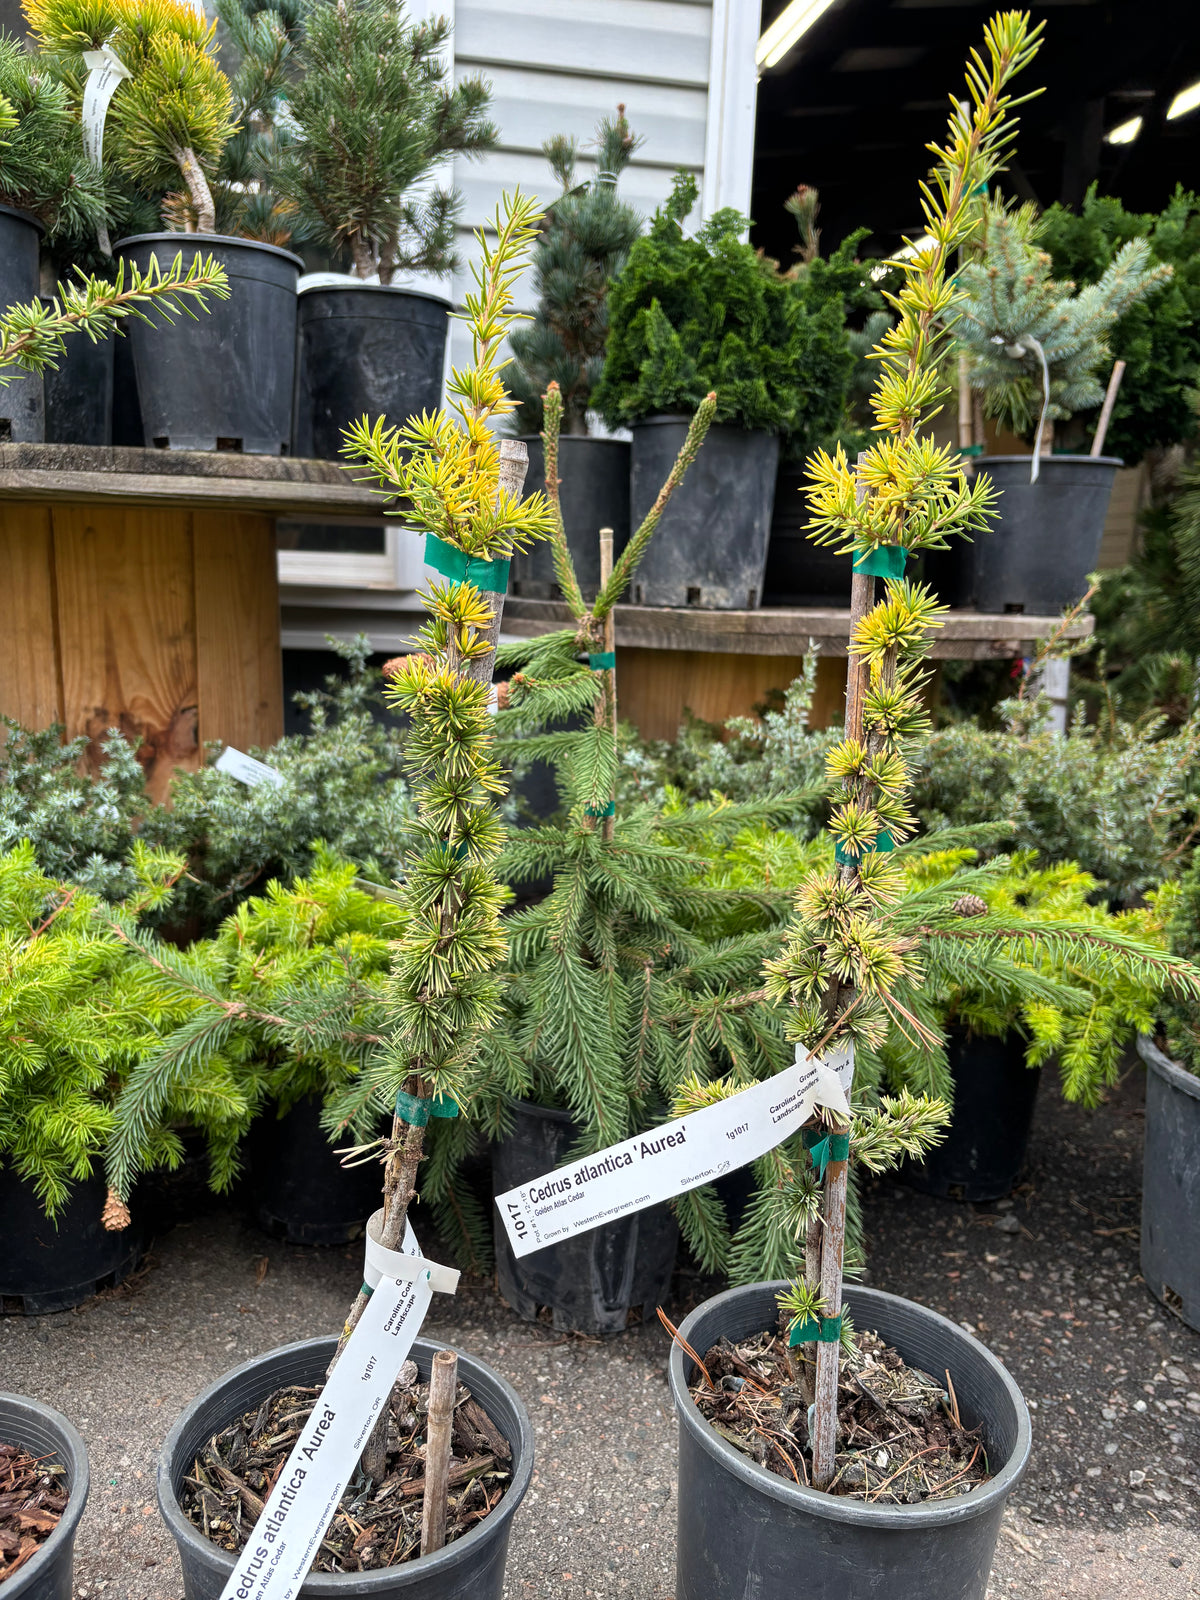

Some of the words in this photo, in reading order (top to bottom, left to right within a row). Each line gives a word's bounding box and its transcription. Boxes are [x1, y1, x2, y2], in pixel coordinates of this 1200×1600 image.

[769, 1094, 796, 1114] Carolina
[796, 1077, 820, 1097] Conifers
[772, 1099, 804, 1124] Landscape
[726, 1123, 749, 1140] 1g1017
[529, 1177, 572, 1204] Cedrus
[574, 1152, 634, 1186] atlantica
[634, 1125, 687, 1160] 'Aurea'
[507, 1204, 528, 1240] 1017
[534, 1205, 554, 1217] Golden
[554, 1199, 568, 1209] Atlas
[568, 1191, 585, 1203] Cedar
[544, 1229, 562, 1240] Grown
[573, 1193, 651, 1228] WesternEvergreen.com
[384, 1299, 404, 1332] Carolina
[391, 1294, 416, 1336] Landscape
[361, 1355, 378, 1382] 1g1017
[372, 1396, 382, 1410] OR
[264, 1468, 308, 1544] atlantica
[298, 1404, 336, 1461] 'Aurea'
[284, 1588, 293, 1600] by
[292, 1482, 342, 1581] WesternEvergreen.com
[262, 1566, 275, 1590] Atlas
[270, 1540, 287, 1566] Cedar
